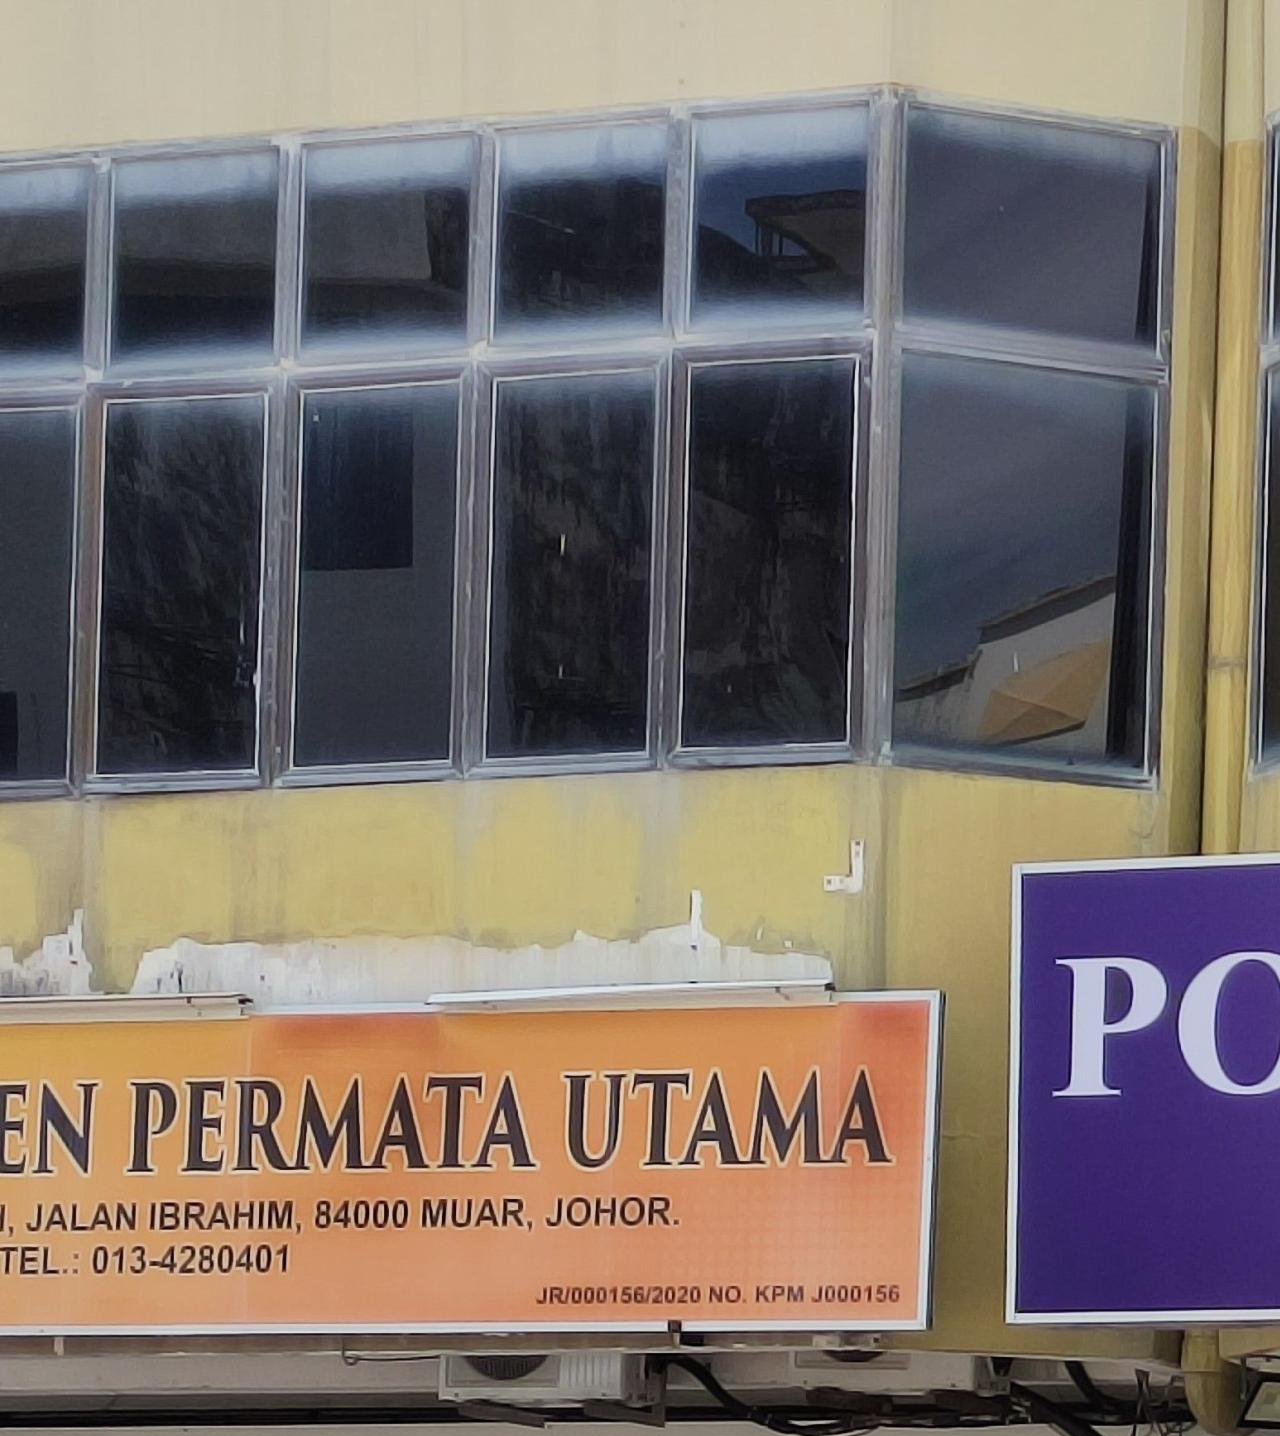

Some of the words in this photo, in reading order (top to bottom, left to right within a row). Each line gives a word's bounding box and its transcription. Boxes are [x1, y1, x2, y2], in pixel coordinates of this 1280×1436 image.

[0, 1081, 98, 1174] EN
[127, 1073, 539, 1173] PERMATA
[564, 1067, 893, 1169] UTAMA
[26, 1202, 136, 1233] JALAN
[149, 1200, 302, 1236] IBRAHIM,
[315, 1200, 409, 1230] 84000
[420, 1198, 533, 1233] MUAR,
[545, 1197, 681, 1229] JOHOR.
[0, 1247, 80, 1276] TEL.:
[92, 1244, 289, 1275] 013-4280401
[536, 1285, 701, 1305] JR/000156/2020
[708, 1286, 748, 1304] NO.
[755, 1285, 804, 1304] KPM
[811, 1284, 901, 1304] J000156
